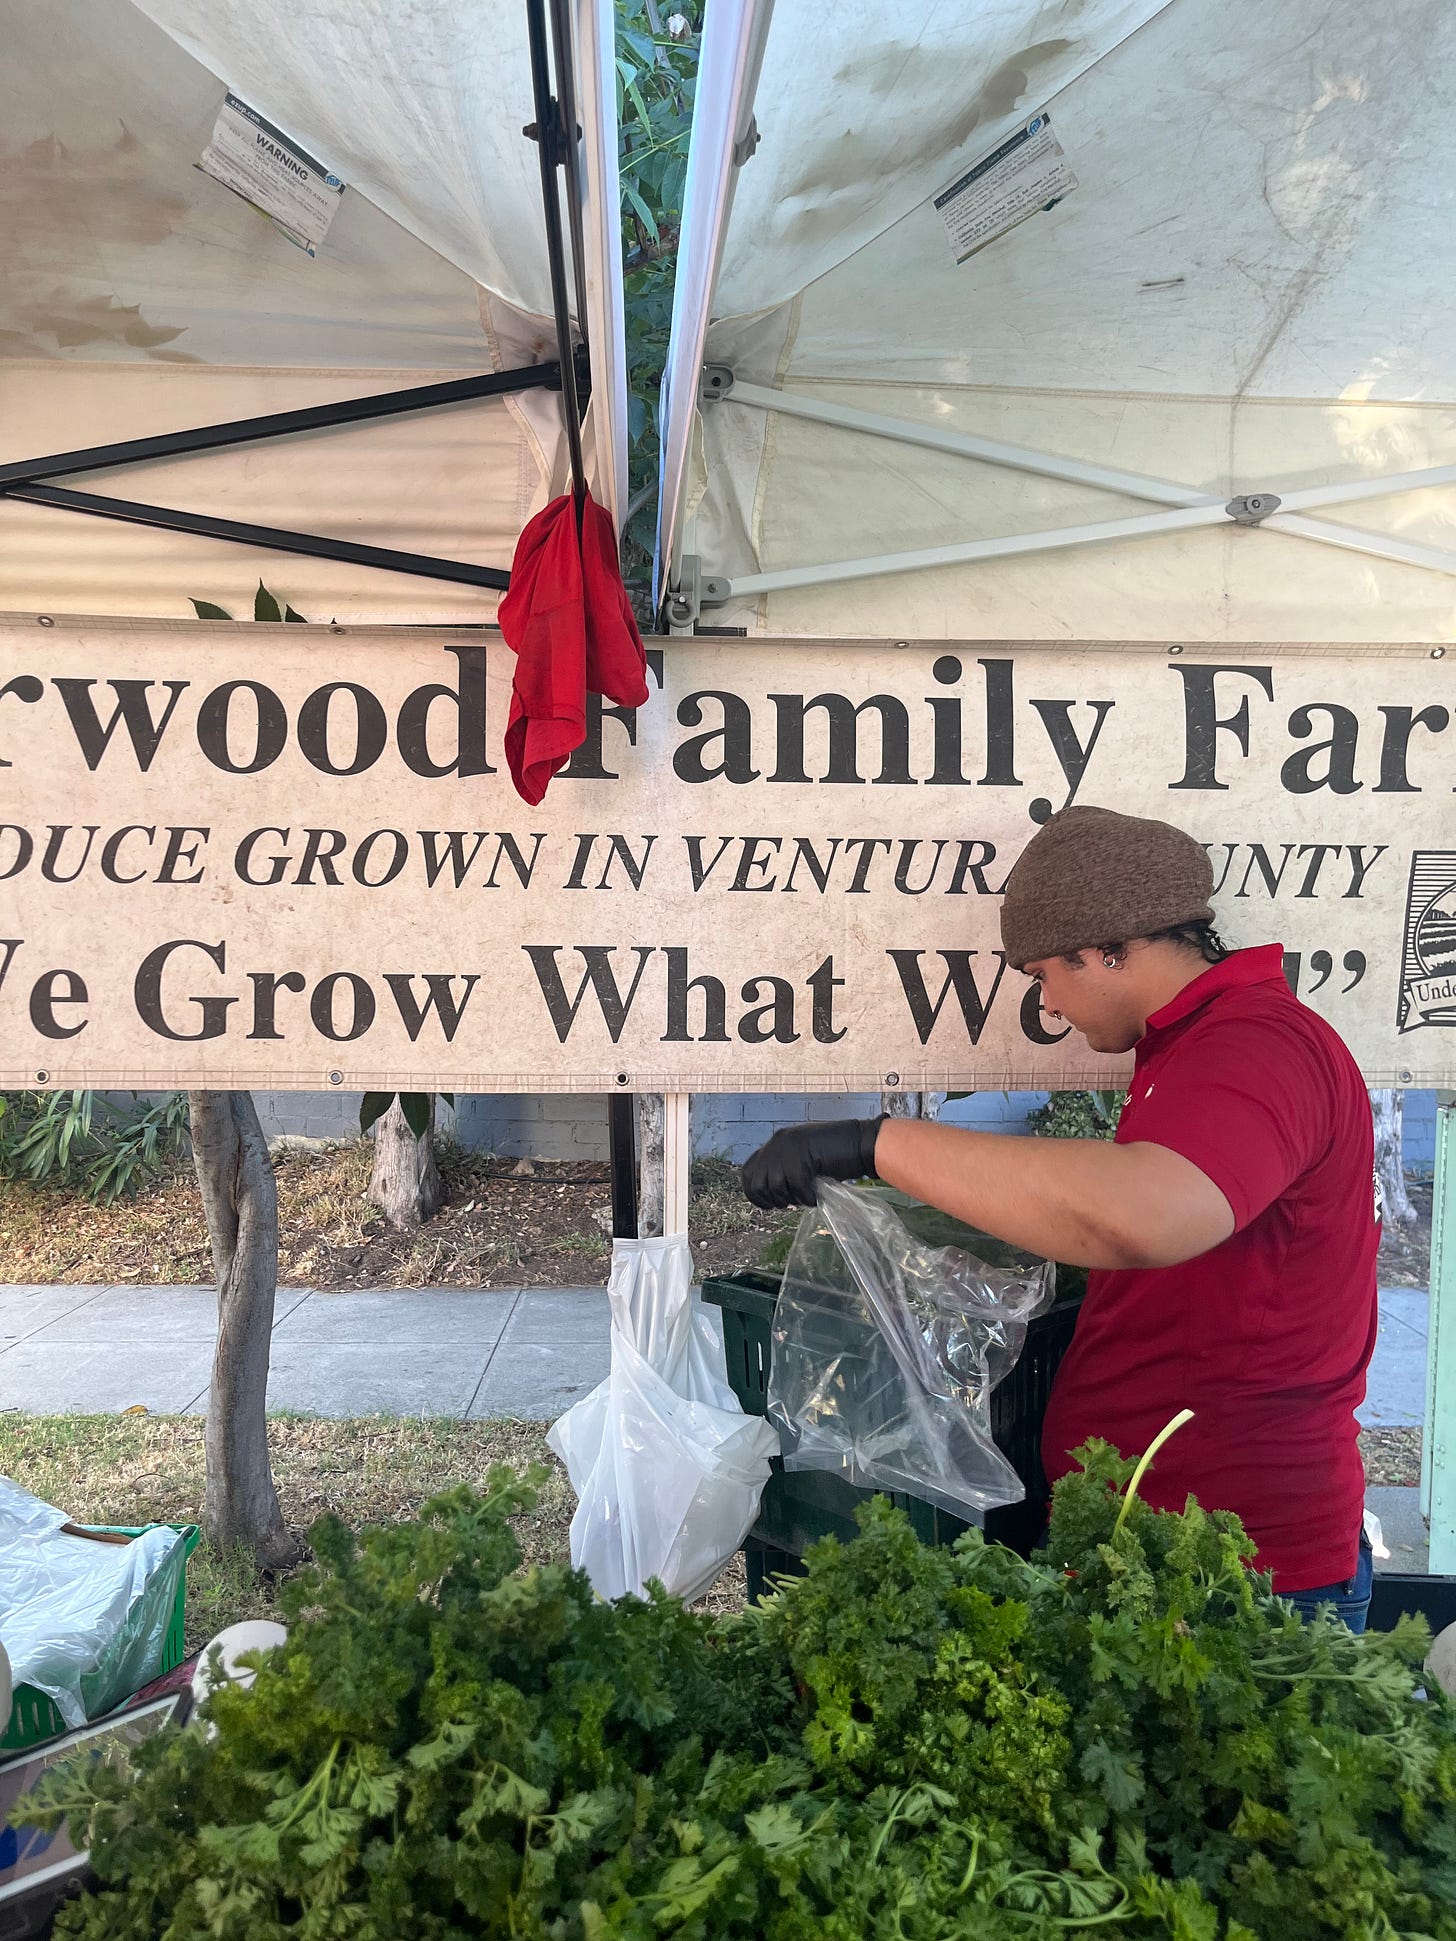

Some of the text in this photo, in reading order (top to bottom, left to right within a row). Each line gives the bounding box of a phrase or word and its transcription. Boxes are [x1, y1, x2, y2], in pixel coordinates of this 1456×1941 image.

[230, 99, 261, 124] ezup.com
[256, 133, 308, 180] WARNING
[1168, 664, 1456, 794] Far
[235, 828, 547, 889] GROWN
[563, 834, 658, 892] IN
[682, 836, 1007, 896] VENTUR
[1200, 843, 1389, 899] UNTY
[135, 940, 480, 1043] Grow
[521, 946, 848, 1043] What
